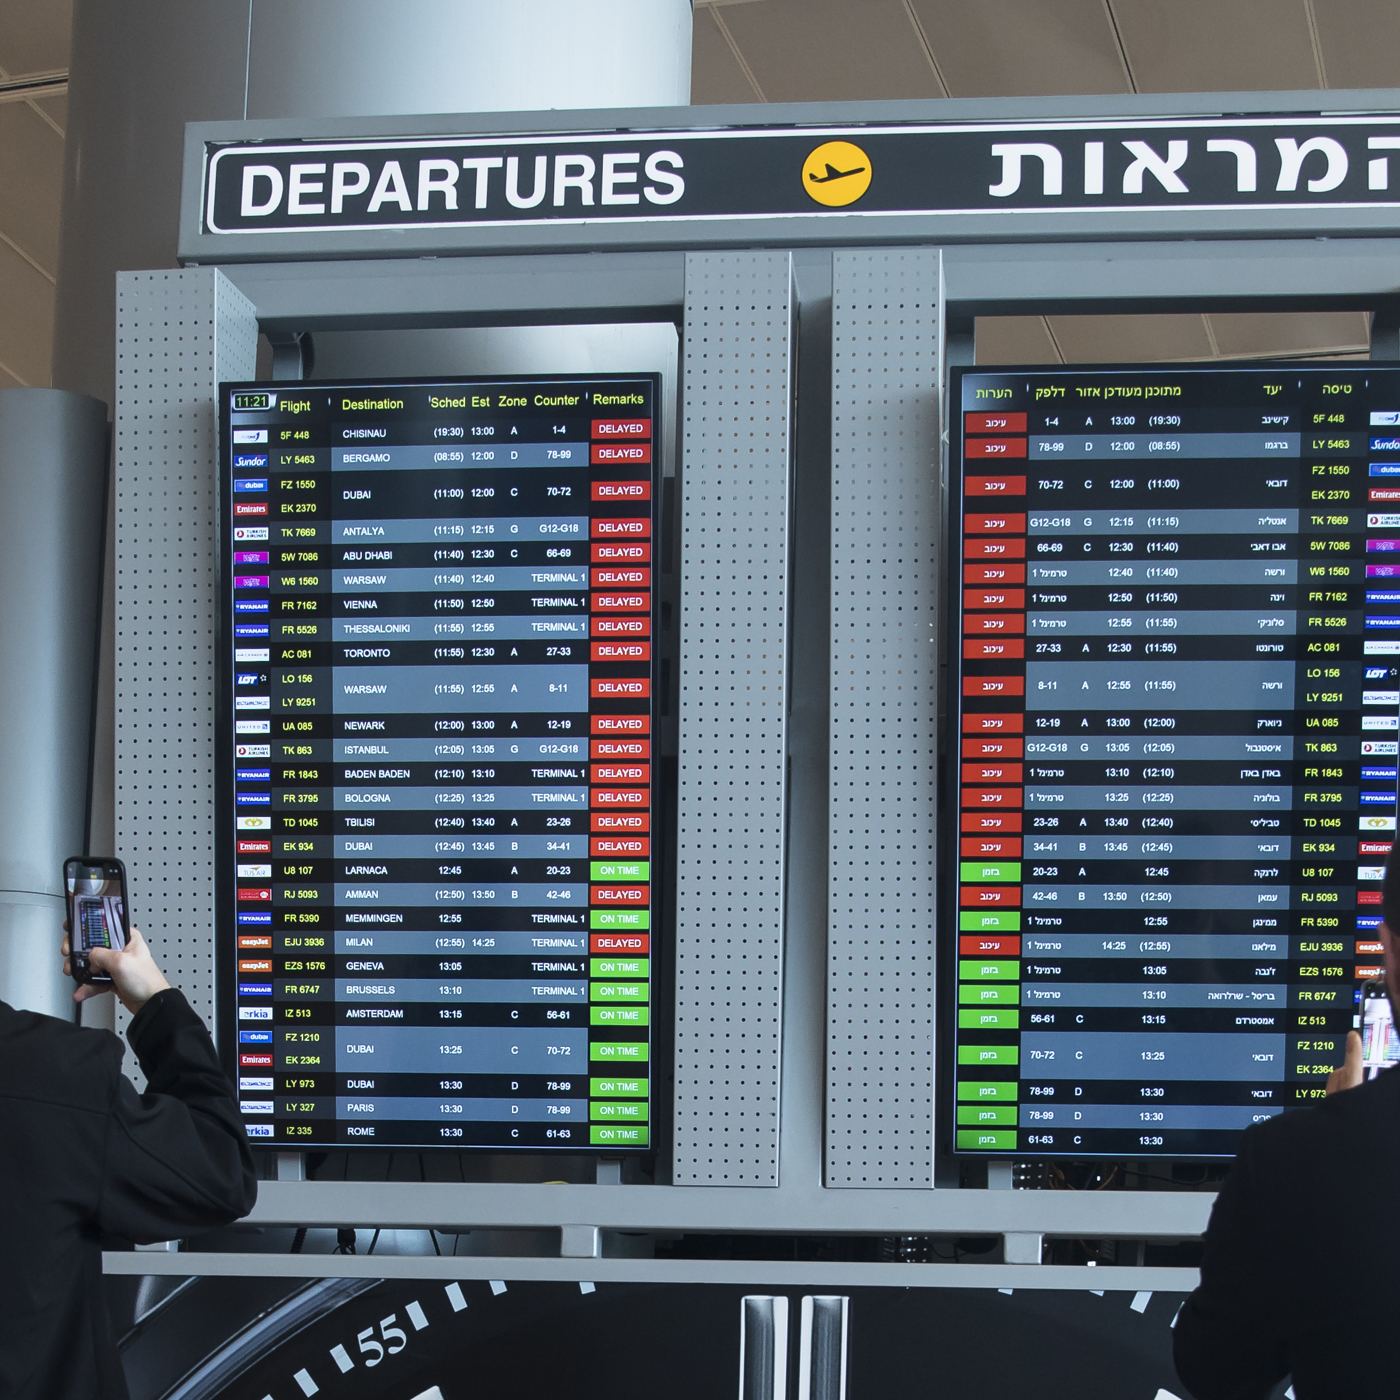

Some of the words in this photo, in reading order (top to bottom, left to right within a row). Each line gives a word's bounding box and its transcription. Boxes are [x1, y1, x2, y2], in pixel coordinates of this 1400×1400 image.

[239, 150, 686, 217] DEPARTURES
[976, 388, 1013, 399] הערות
[1035, 385, 1066, 400] דלפק
[1075, 387, 1101, 397] אזור
[1104, 386, 1143, 400] מעודכן
[1144, 386, 1182, 399] מתוכנן
[1263, 385, 1282, 396] יעד
[1322, 384, 1353, 395] טיסה
[237, 396, 267, 408] 11:21
[279, 400, 311, 415] Flight
[342, 398, 404, 411] Destination
[431, 397, 466, 409] Sched
[471, 396, 490, 408] Est
[498, 395, 528, 408] Zone
[534, 394, 580, 407] Counter
[593, 393, 644, 405] Remarks
[985, 419, 1007, 428] עיכוב
[1044, 417, 1059, 426] 1-4
[1085, 416, 1093, 426] A
[1110, 416, 1136, 426] 13:00
[1148, 415, 1181, 427] (19:30)
[1261, 416, 1290, 426] קישינב
[1313, 414, 1326, 424] 5F
[1327, 414, 1345, 424] 448
[280, 430, 292, 440] 5F
[293, 430, 310, 440] 448
[342, 428, 387, 439] CHISINAU
[433, 427, 464, 439] (19:30)
[471, 426, 495, 436] 13:00
[510, 426, 518, 435] A
[552, 425, 566, 434] 1-4
[598, 423, 644, 434] DELAYED
[1264, 441, 1289, 450] ברגמו
[280, 455, 293, 465] LY
[294, 455, 315, 464] 5463
[342, 453, 391, 463] BERGAMO
[433, 451, 464, 463] (08:55)
[471, 451, 495, 461] 12:00
[510, 450, 518, 460] D
[546, 449, 572, 459] 78-99
[598, 448, 644, 459] DELAYED
[984, 482, 1006, 491] עיכוב
[1265, 479, 1288, 488] דובאי
[343, 490, 371, 500] DUBAI
[1258, 516, 1287, 526] אנטליה
[342, 526, 385, 536] ANTALYA
[1250, 543, 1270, 551] דאבי
[1271, 543, 1287, 551] אבו
[342, 551, 363, 561] ABU
[364, 550, 393, 561] DHABI
[1264, 568, 1286, 576] ורשה
[343, 575, 387, 585] WARSAW
[1270, 593, 1285, 602] וינה
[281, 601, 295, 610] FR
[296, 600, 317, 610] 7162
[343, 600, 378, 609] VIENNA
[433, 598, 464, 610] (11:50)
[471, 598, 495, 608] 12:50
[530, 597, 579, 607] TERMINAL
[580, 597, 585, 607] 1
[598, 597, 643, 607] DELAYED
[343, 624, 411, 634] THESSALONIKI
[343, 648, 391, 658] TORONTO
[343, 684, 388, 694] WARSAW
[344, 721, 386, 731] NEWARK
[1257, 719, 1282, 729] ניוארק
[344, 745, 390, 755] ISTANBUL
[1245, 743, 1282, 752] איסטנבול
[344, 769, 377, 779] BADEN
[378, 769, 411, 779] BADEN
[1240, 769, 1260, 779] באדן
[1261, 769, 1281, 779] באדן
[344, 793, 391, 803] BOLOGNA
[981, 794, 1002, 802] עיכוב
[1029, 792, 1034, 802] 1
[1036, 793, 1064, 802] טרמינל
[1104, 792, 1129, 802] 13:25
[1142, 792, 1174, 804] (12:25)
[1253, 793, 1281, 802] בולוניה
[1304, 793, 1318, 802] FR
[1320, 793, 1343, 803] 3795
[344, 817, 375, 827] TBILISI
[1250, 818, 1280, 827] טביליסי
[345, 841, 373, 851] DUBAI
[345, 865, 388, 875] LARNACA
[982, 868, 1001, 878] בזמן
[1253, 867, 1279, 879] לרנקה
[284, 890, 296, 899] RJ
[297, 890, 319, 899] 5093
[345, 890, 379, 899] AMMAN
[435, 890, 465, 901] (12:50)
[472, 890, 496, 899] 13:50
[511, 890, 519, 899] B
[546, 890, 571, 899] 42-46
[598, 890, 642, 900] DELAYED
[1257, 894, 1278, 903] עמאן
[345, 913, 403, 923] MEMMINGEN
[1252, 918, 1277, 928] ממינגן
[345, 937, 373, 947] MILAN
[345, 961, 385, 971] GENEVA
[1255, 966, 1277, 976] ז'נבה
[346, 985, 396, 995] BRUSSELS
[285, 1008, 294, 1018] IZ
[295, 1008, 312, 1018] 513
[345, 1009, 404, 1018] AMSTERDAM
[439, 1009, 463, 1019] 13:15
[510, 1010, 519, 1019] C
[546, 1010, 570, 1020] 56-61
[599, 1010, 615, 1020] ON
[616, 1010, 639, 1020] TIME
[1235, 1017, 1275, 1025] אמסטרדם
[346, 1044, 375, 1054] DUBAI
[979, 1051, 998, 1061] בזמן
[347, 1079, 375, 1089] DUBAI
[347, 1103, 375, 1113] PARIS
[347, 1127, 375, 1136] ROME
[357, 1313, 407, 1367] 55
